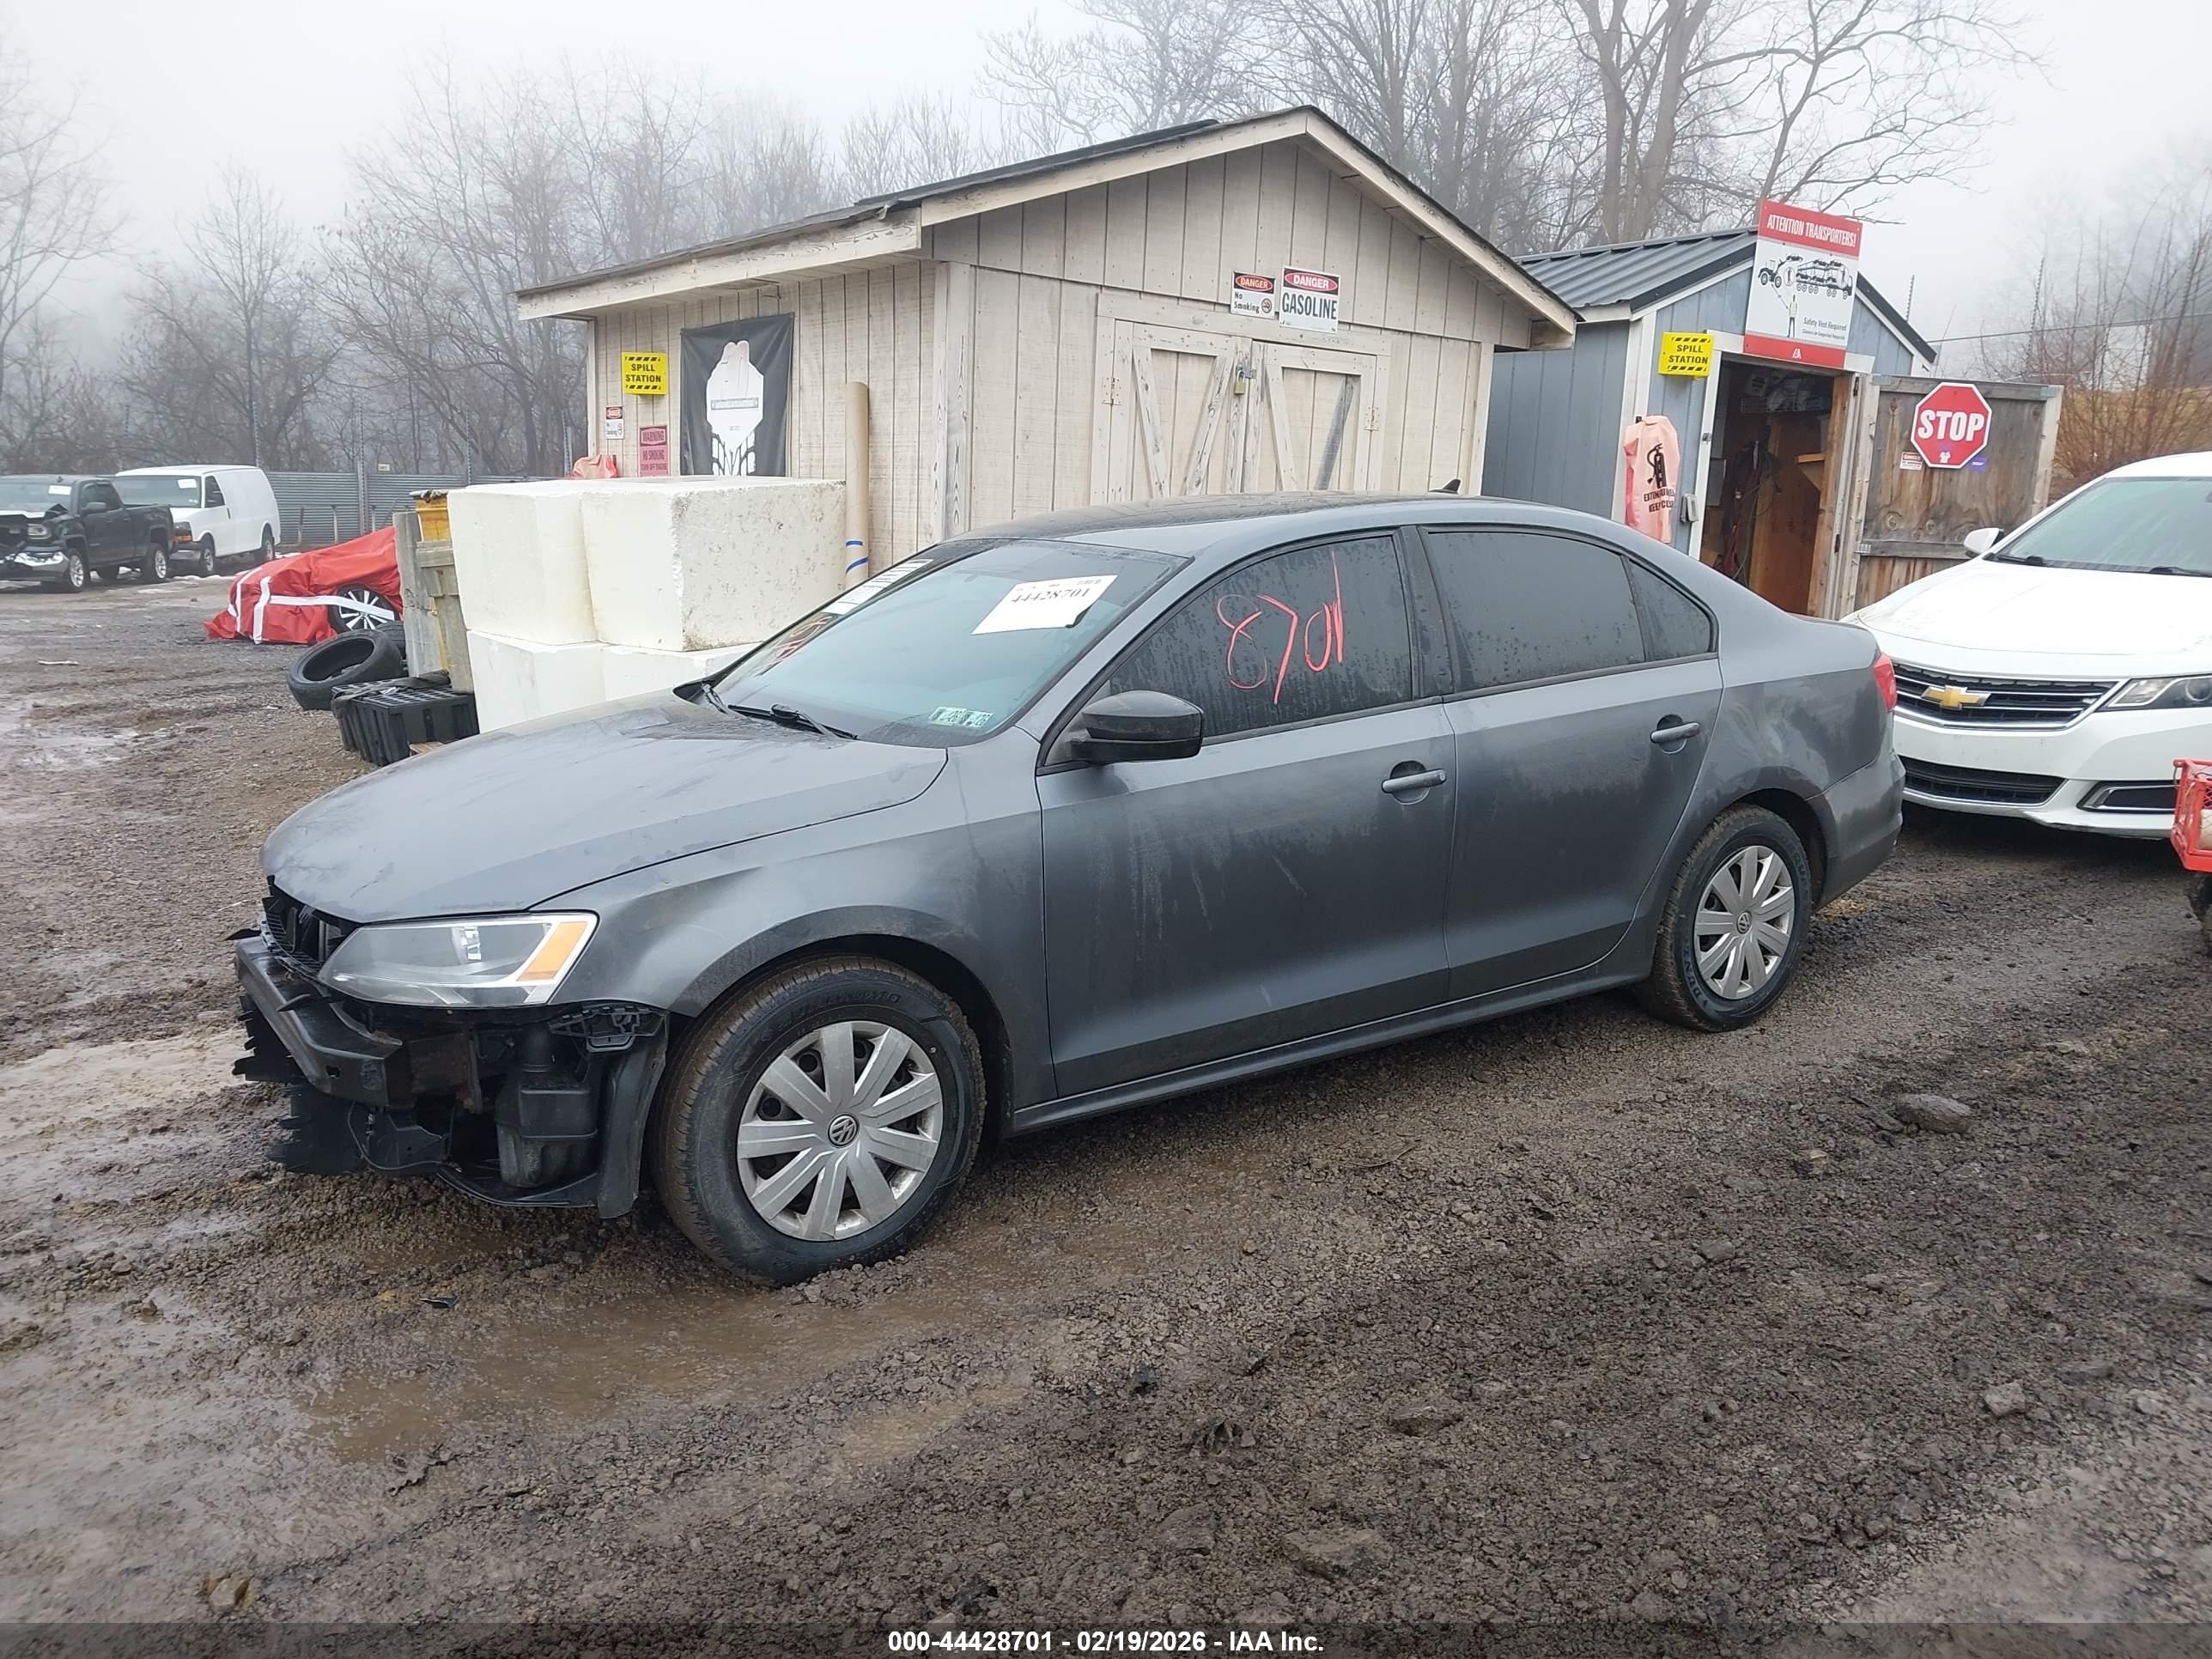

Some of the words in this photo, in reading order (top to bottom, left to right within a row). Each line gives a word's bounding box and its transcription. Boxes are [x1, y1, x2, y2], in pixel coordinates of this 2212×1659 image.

[1766, 214, 1805, 236] ATTENTION
[1805, 222, 1856, 247] TRANSPORTERS!
[1240, 276, 1268, 289] DANGER
[1293, 274, 1329, 289] DANGER
[1234, 291, 1243, 300] No
[1233, 301, 1260, 313] Smoking
[1282, 292, 1337, 319] GASOLINE
[1676, 344, 1704, 353] SPILL
[1668, 355, 1709, 364] STATION
[631, 363, 656, 372] SPILL
[1917, 410, 1985, 441] STOP
[1011, 587, 1091, 603] 44428701
[1217, 550, 1345, 704] 8701
